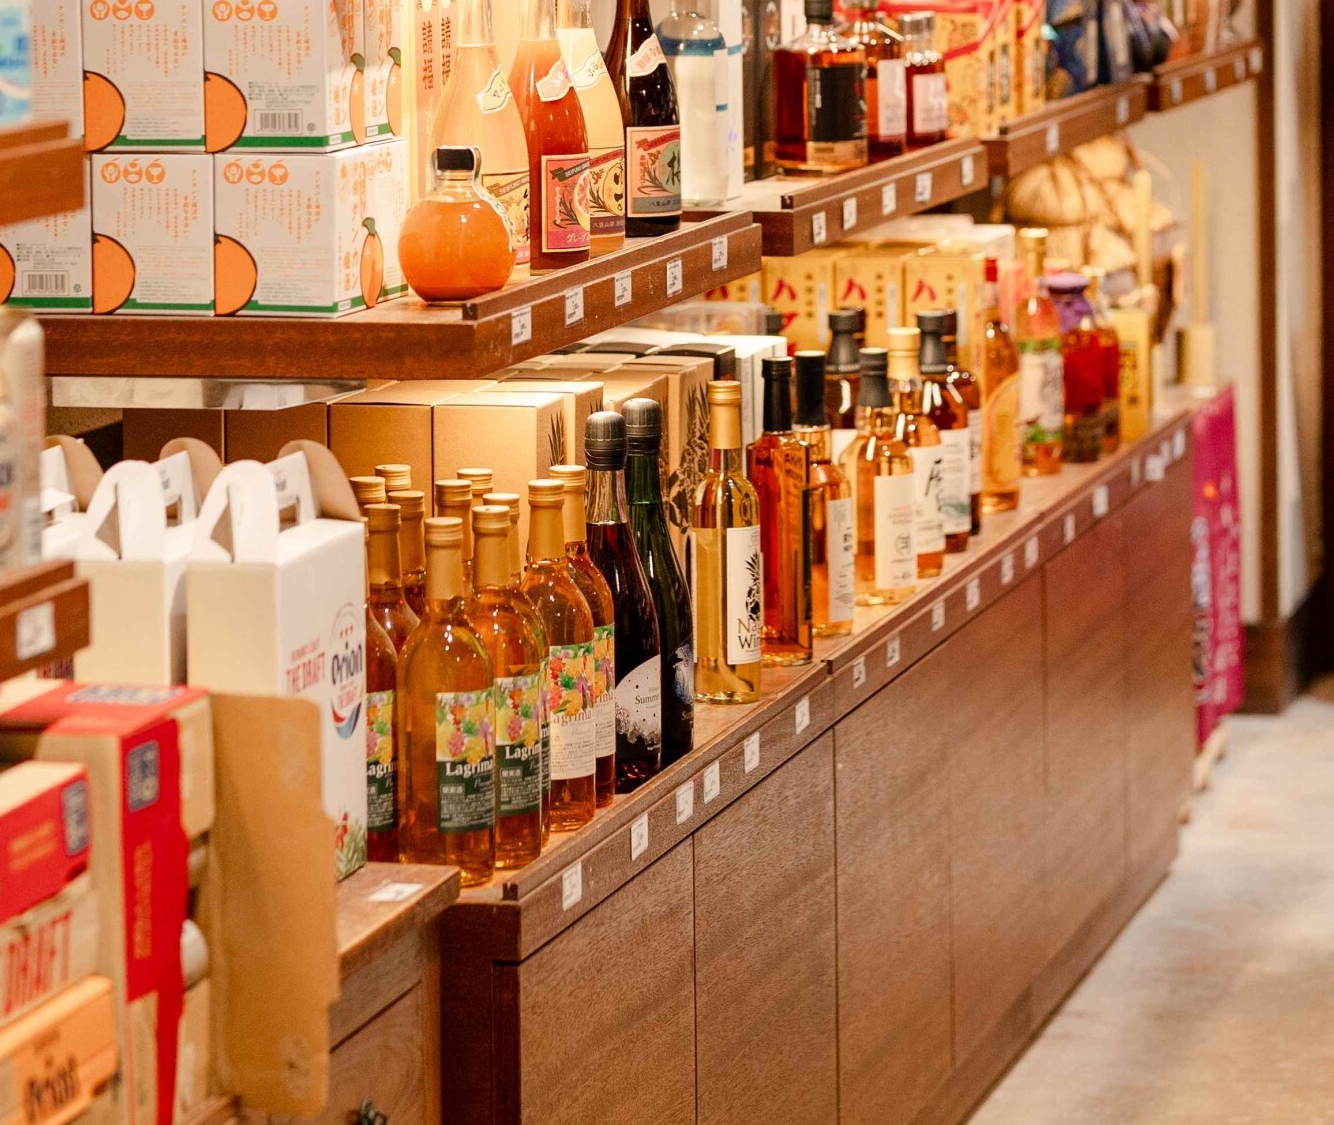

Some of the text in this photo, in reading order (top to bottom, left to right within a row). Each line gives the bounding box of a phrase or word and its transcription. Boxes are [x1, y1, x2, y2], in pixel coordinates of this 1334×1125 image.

[737, 634, 761, 651] Win
[634, 693, 660, 705] Summe
[504, 743, 541, 761] Lagrim
[2, 908, 73, 1018] DRAFT
